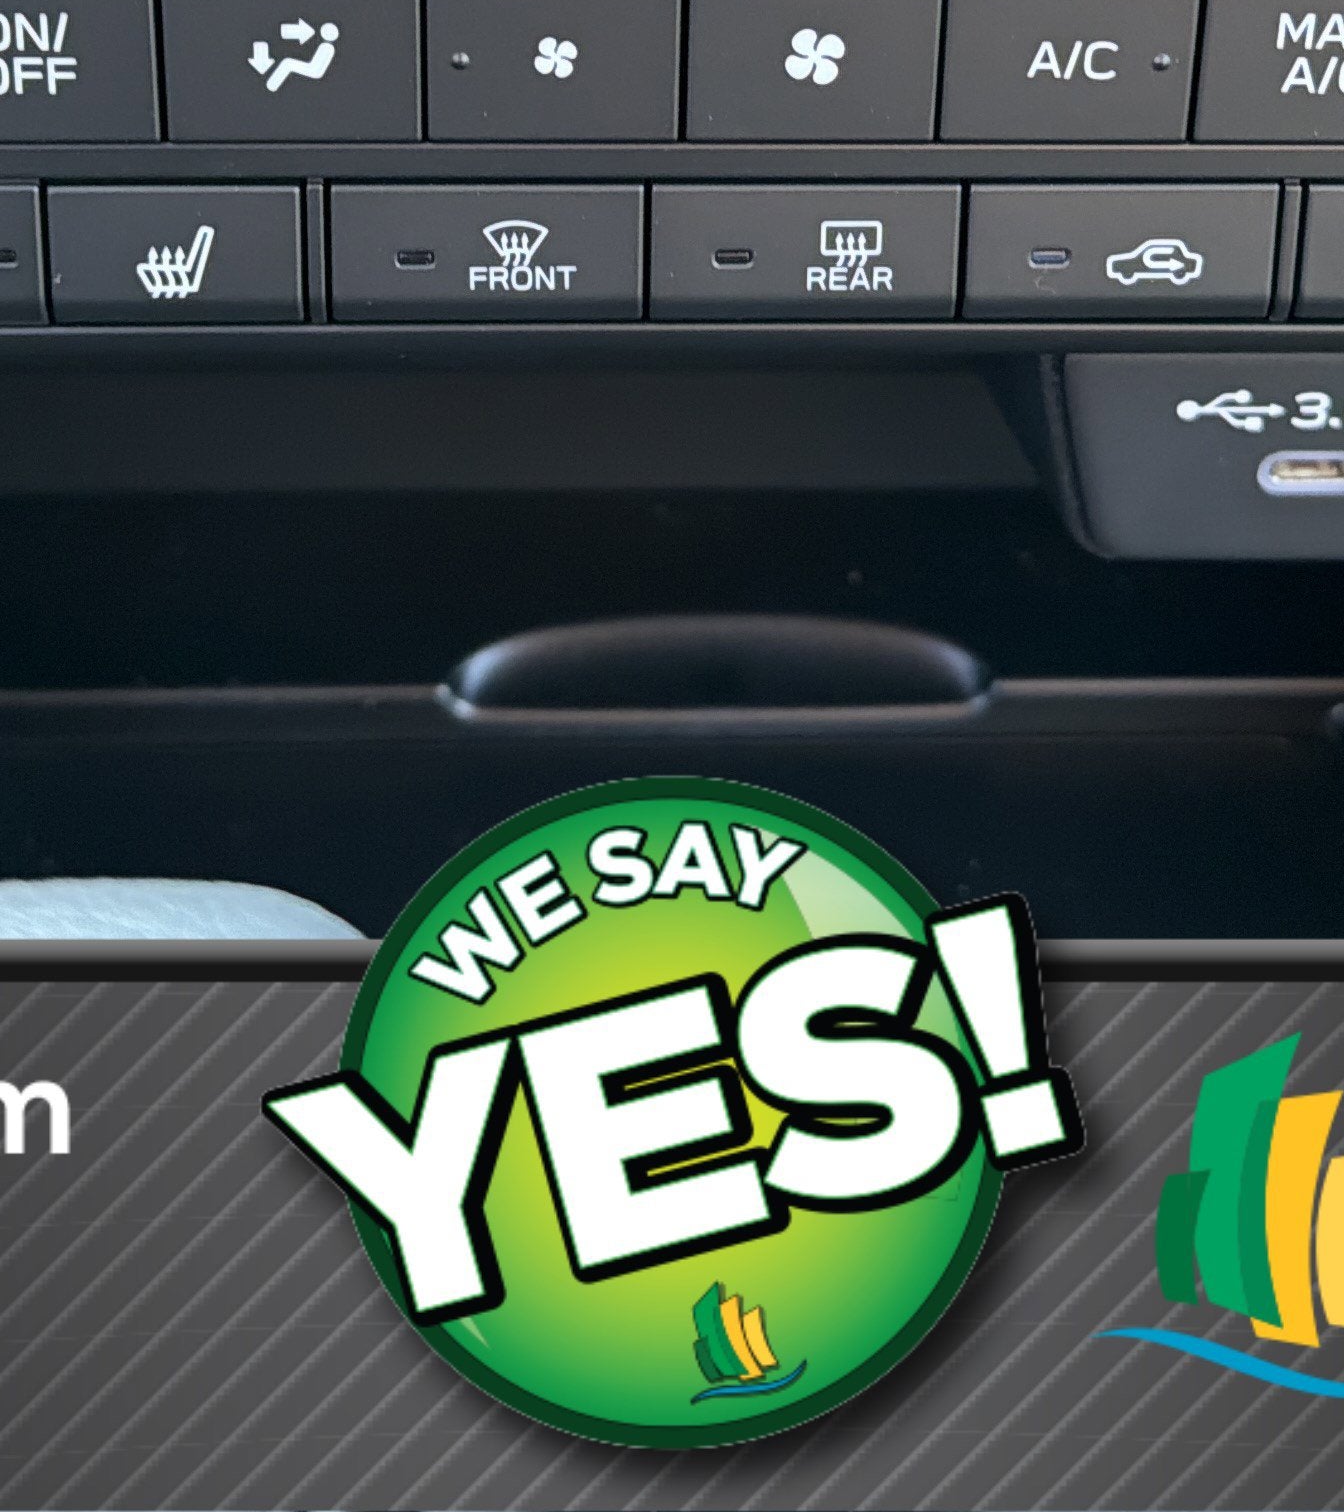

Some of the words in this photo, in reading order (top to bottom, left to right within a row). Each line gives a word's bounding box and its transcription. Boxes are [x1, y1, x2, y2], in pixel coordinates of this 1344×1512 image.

[1026, 41, 1119, 82] A/C
[468, 265, 578, 292] FRONT
[806, 266, 894, 291] REAR
